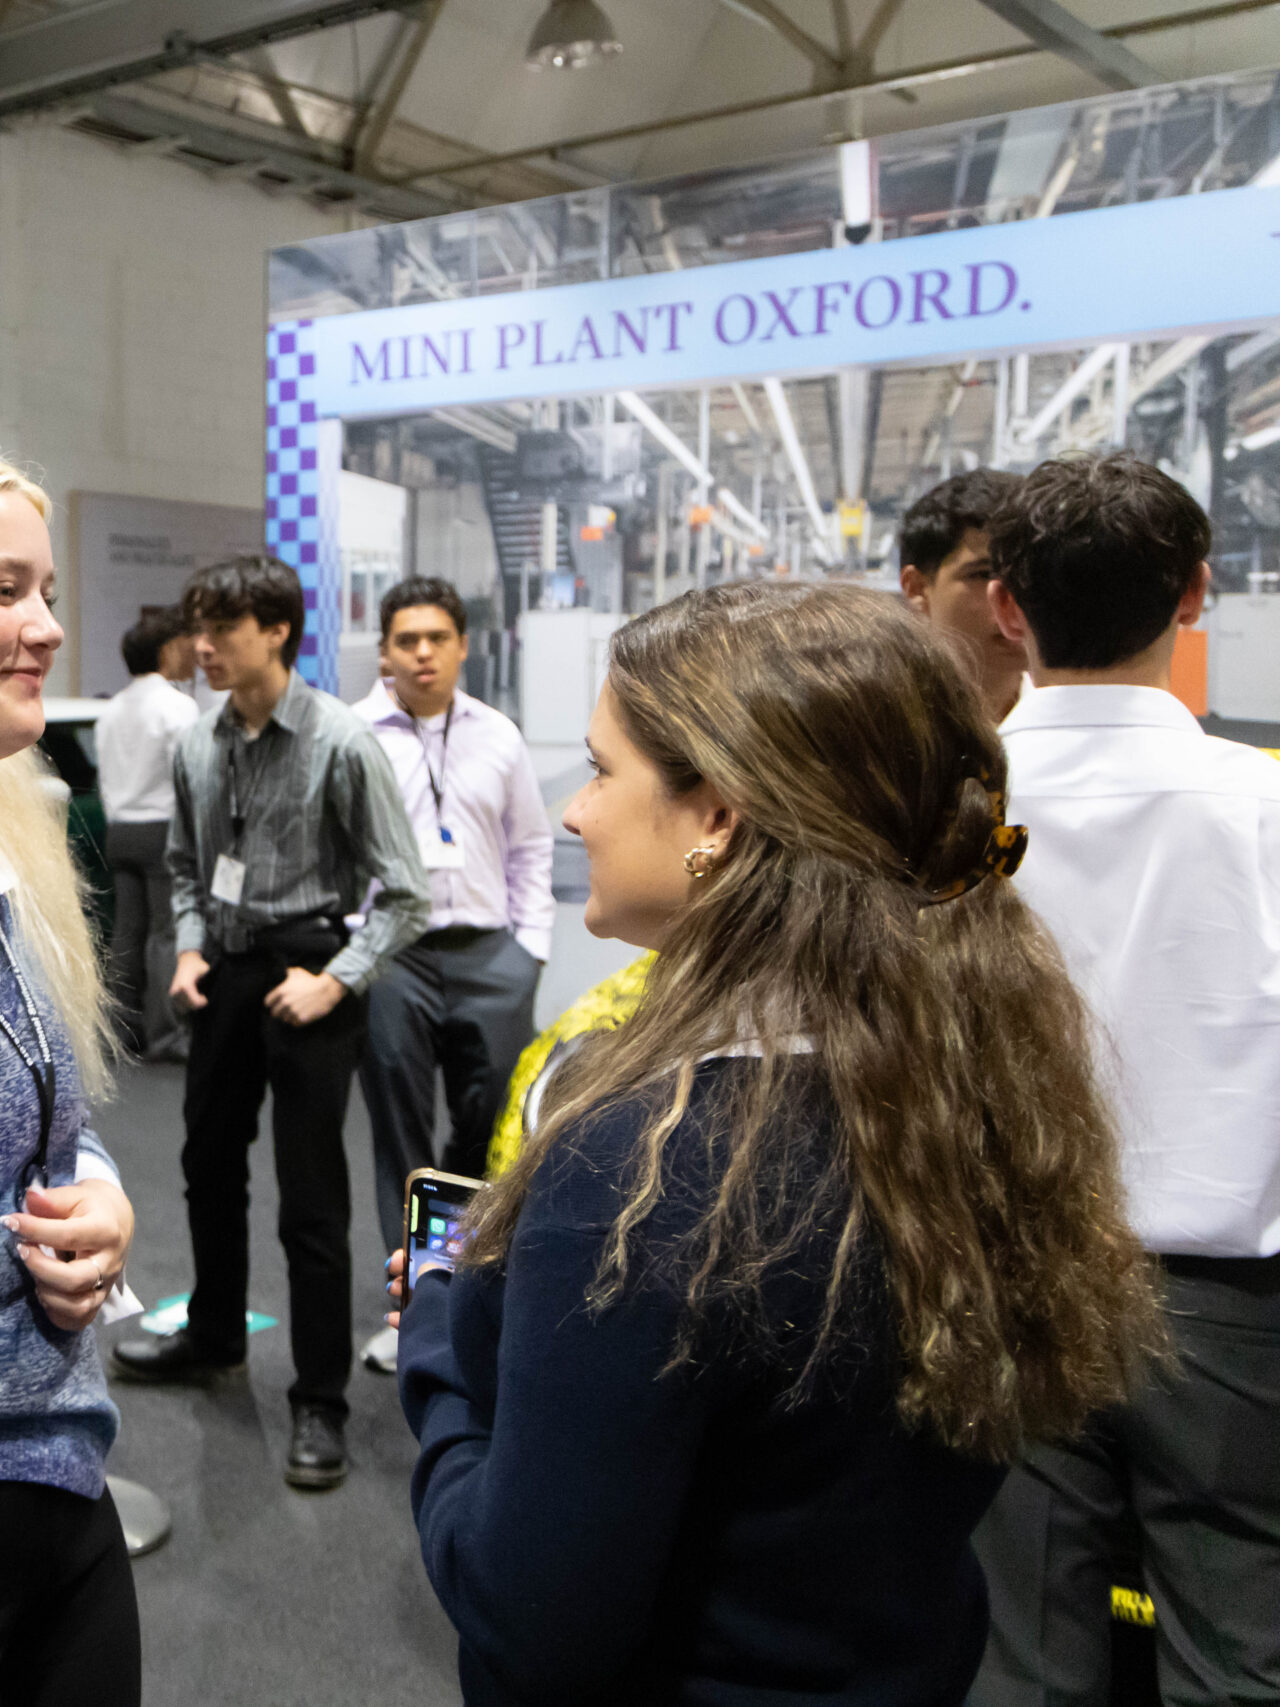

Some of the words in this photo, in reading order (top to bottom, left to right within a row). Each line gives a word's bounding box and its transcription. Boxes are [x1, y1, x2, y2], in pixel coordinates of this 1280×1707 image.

[348, 327, 475, 386] MINI
[494, 301, 693, 370] PLANT
[714, 260, 1032, 346] OXFORD.
